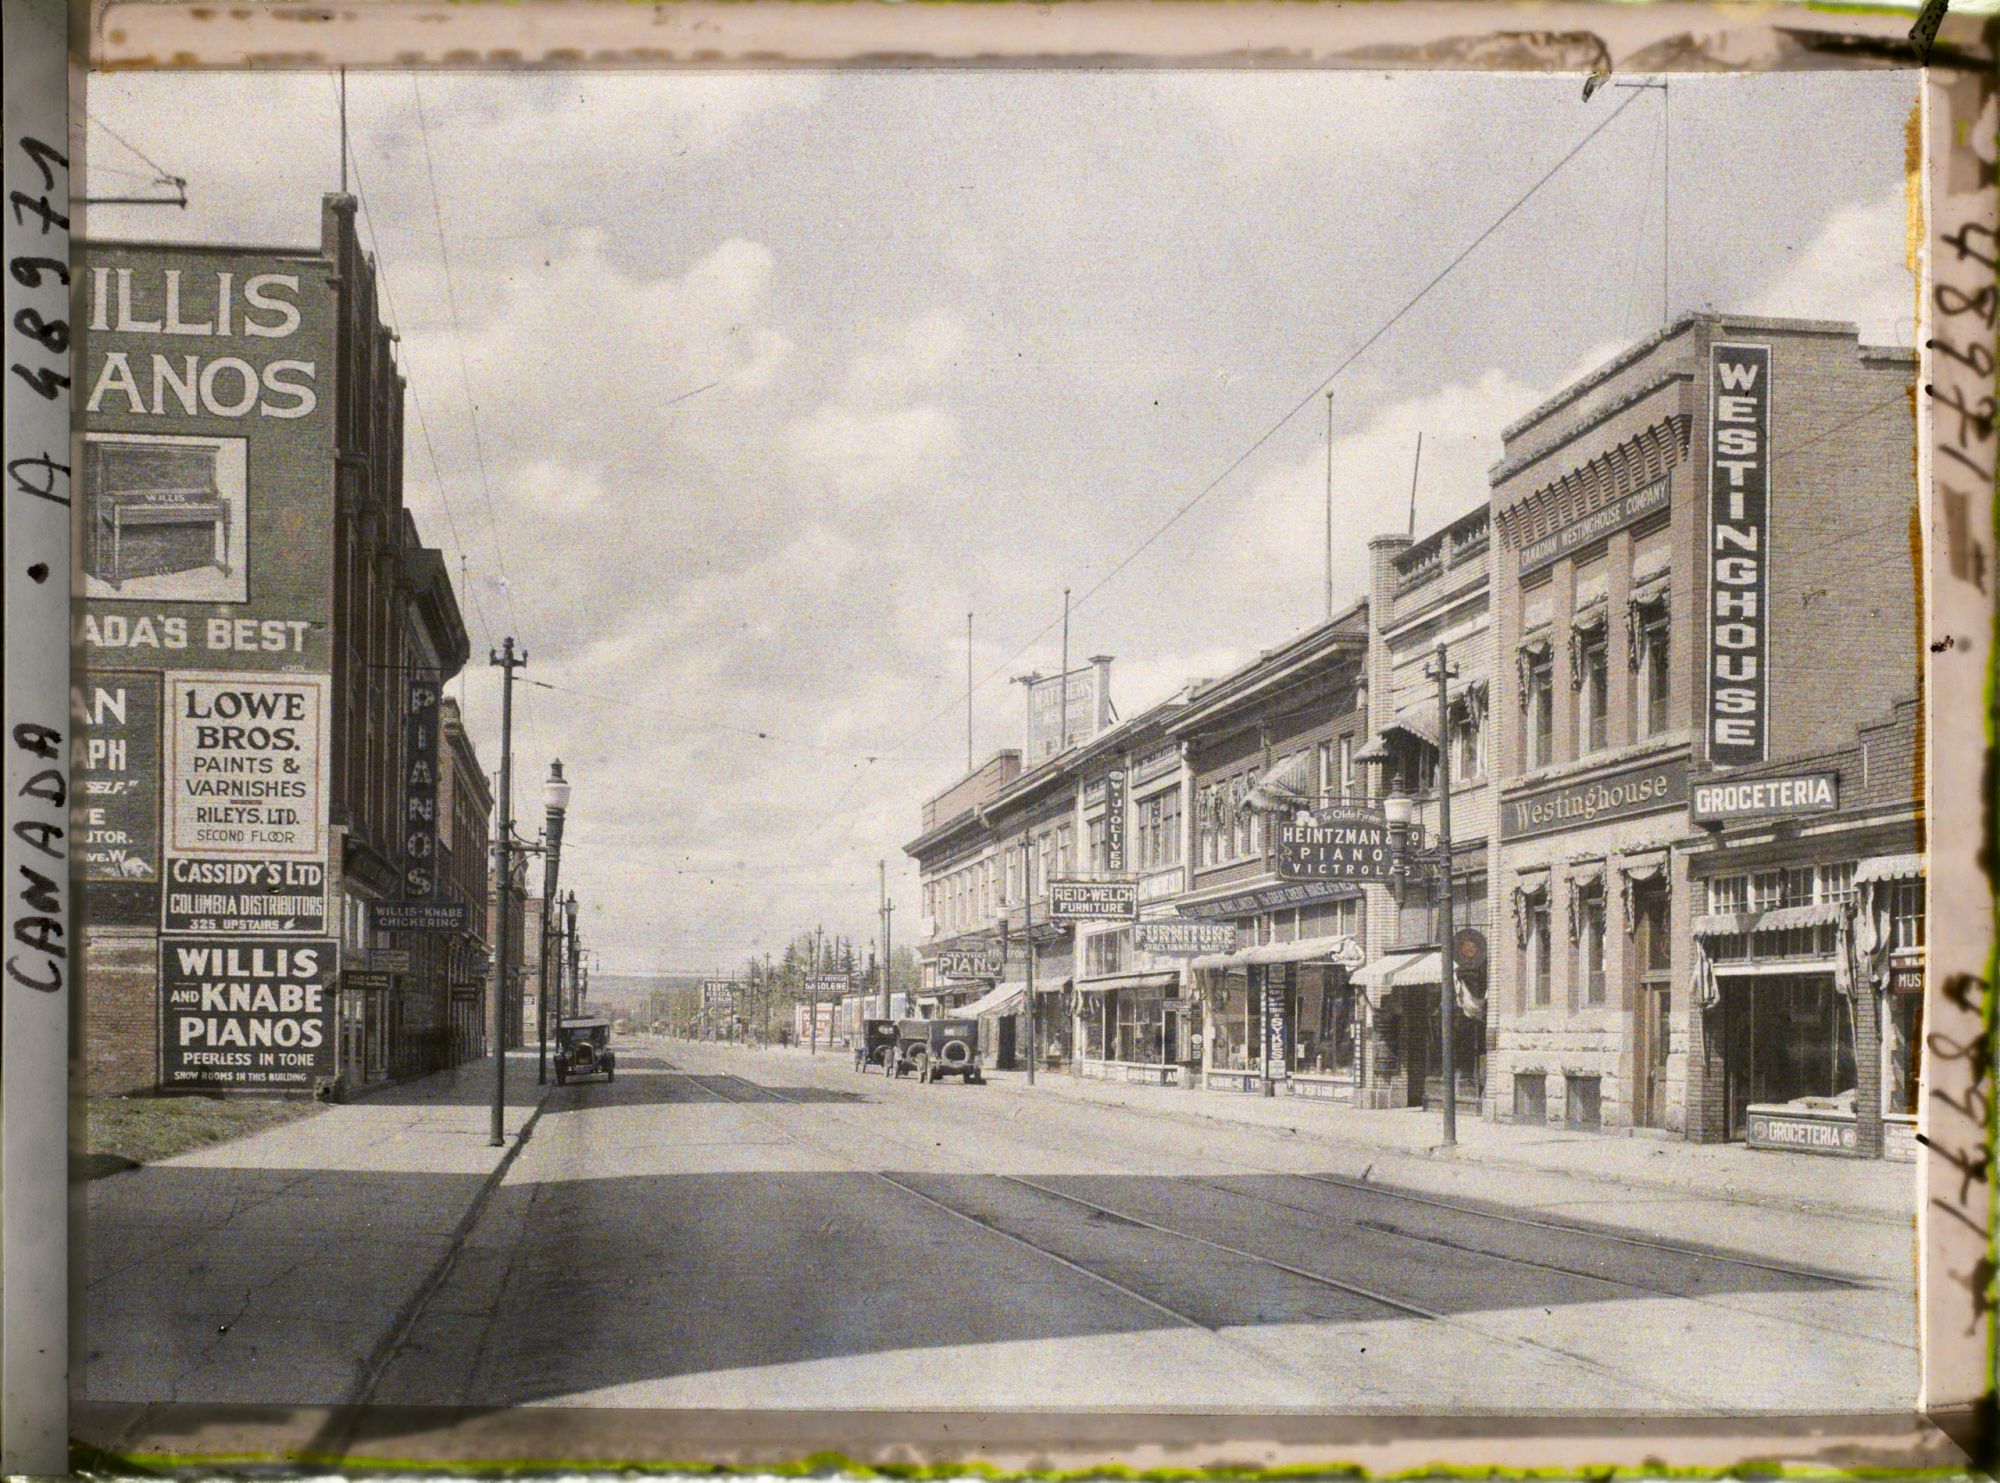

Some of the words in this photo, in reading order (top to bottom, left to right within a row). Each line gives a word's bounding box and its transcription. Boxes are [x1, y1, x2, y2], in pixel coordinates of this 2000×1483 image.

[86, 352, 317, 419] ANOS
[1521, 535, 1557, 567] CANADIAN
[1562, 504, 1621, 553] WESTINGHOUSE
[1625, 480, 1668, 523] COMPANY
[1714, 363, 1758, 746] WESTINGHOUSE
[207, 616, 309, 653] BEST
[186, 690, 305, 721] LOWE
[197, 725, 301, 751] BROS.
[194, 757, 272, 775] PAINTS
[284, 758, 301, 774] &
[186, 780, 306, 799] VARNISHES
[406, 686, 435, 897] PIANOS
[1516, 773, 1667, 832] Westinghouse
[1696, 778, 1832, 814] GROCETERIA
[267, 807, 300, 825] LTD.
[196, 828, 244, 843] SECOND
[251, 829, 295, 844] FLOOR
[1283, 827, 1380, 845] HEINTZMAN
[8, 722, 67, 994] CANADA
[173, 860, 281, 885] CASSIDY'S
[286, 863, 322, 886] LTD
[170, 894, 237, 916] COLUMBIA
[240, 895, 323, 917] DISTRIBUTORS
[1055, 888, 1133, 902] REID-WELCH
[1060, 902, 1124, 914] FURNITURE
[190, 918, 216, 931] 325
[223, 919, 281, 931] UPSTAIRS
[379, 917, 460, 928] CHICKERING
[1135, 926, 1236, 944] FURNITURE
[176, 948, 318, 978] WILLIS
[170, 989, 199, 1003] AND
[201, 984, 323, 1013] KNABE
[179, 1018, 323, 1048] PIANOS
[1270, 1018, 1284, 1059] SYKES
[183, 1052, 251, 1066] PEERLESS
[259, 1053, 275, 1066] IN
[279, 1053, 314, 1066] TONE
[174, 1071, 198, 1081] SHOW
[201, 1071, 233, 1081] ROOMS
[236, 1072, 246, 1081] IN
[247, 1072, 266, 1082] THIS
[269, 1072, 306, 1082] BUILDING
[1768, 1121, 1840, 1146] GROCETERIA
